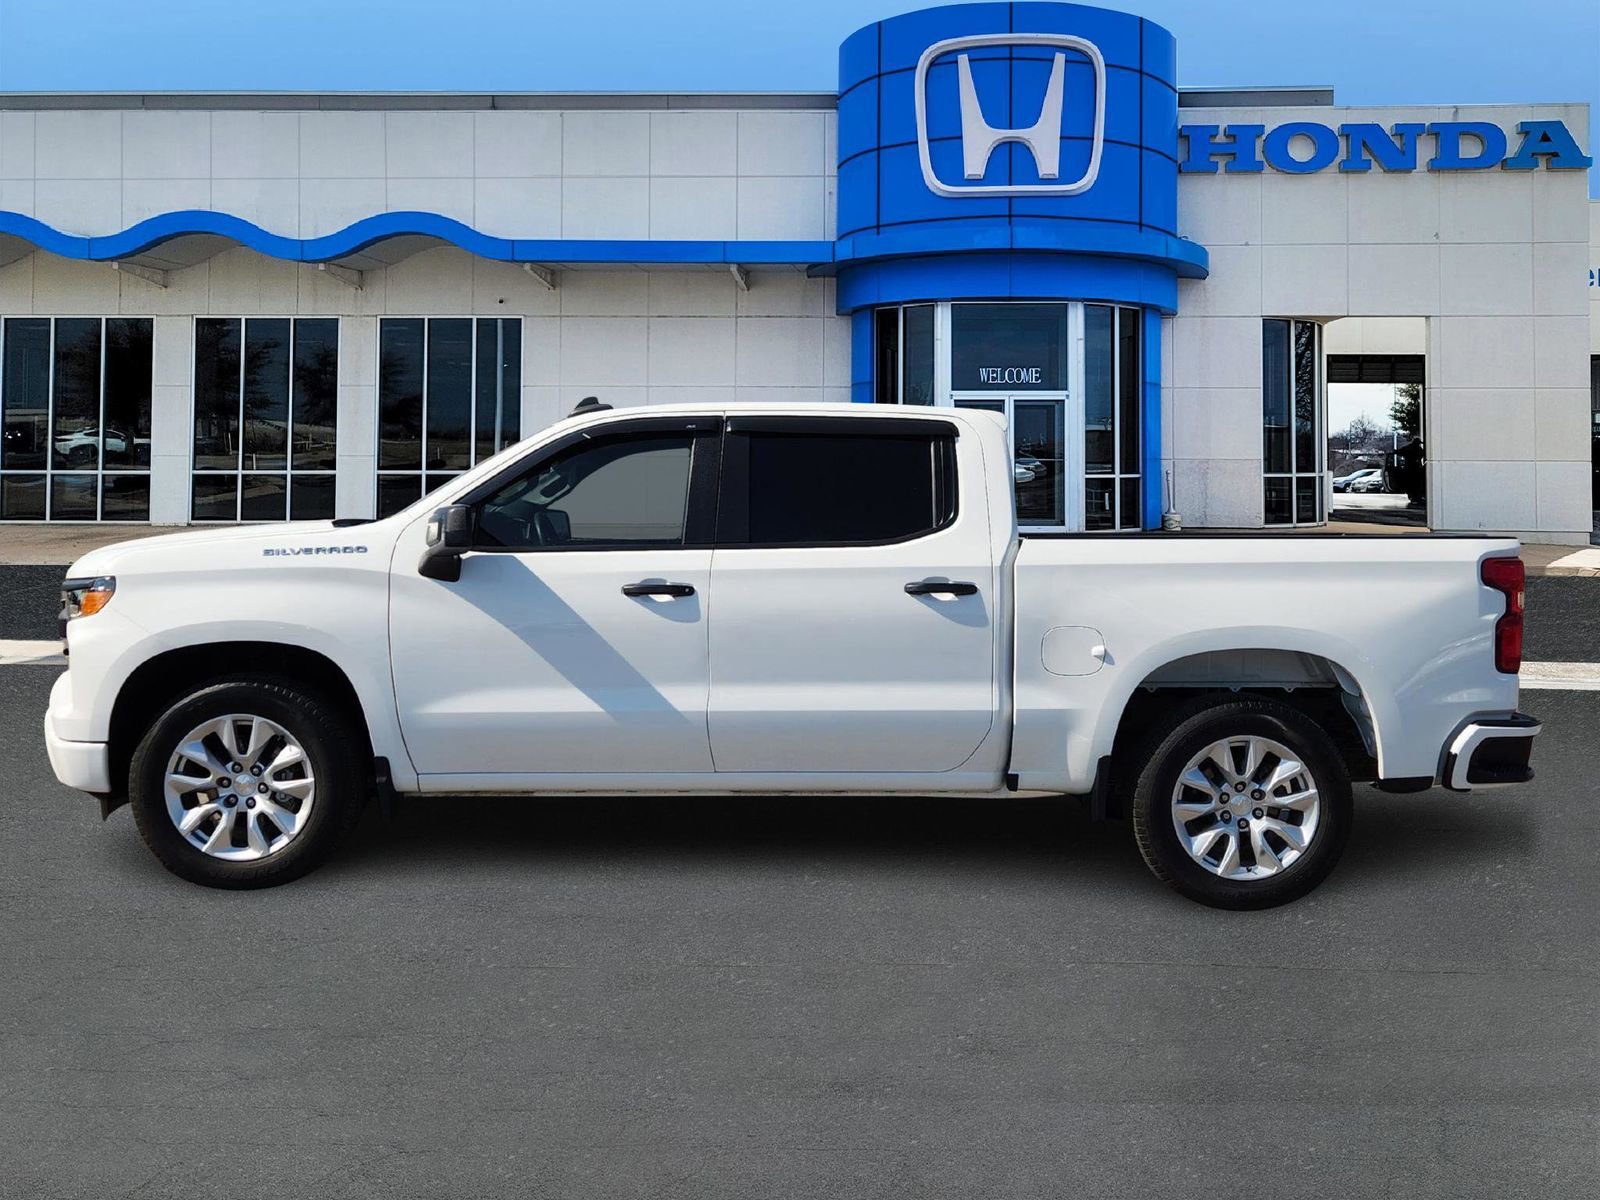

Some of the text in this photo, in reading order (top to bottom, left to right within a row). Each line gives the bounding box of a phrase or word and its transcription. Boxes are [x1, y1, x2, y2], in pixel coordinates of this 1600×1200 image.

[1179, 120, 1592, 174] HONDA
[979, 367, 1041, 384] WELCOME
[263, 545, 368, 556] SILVERADO
